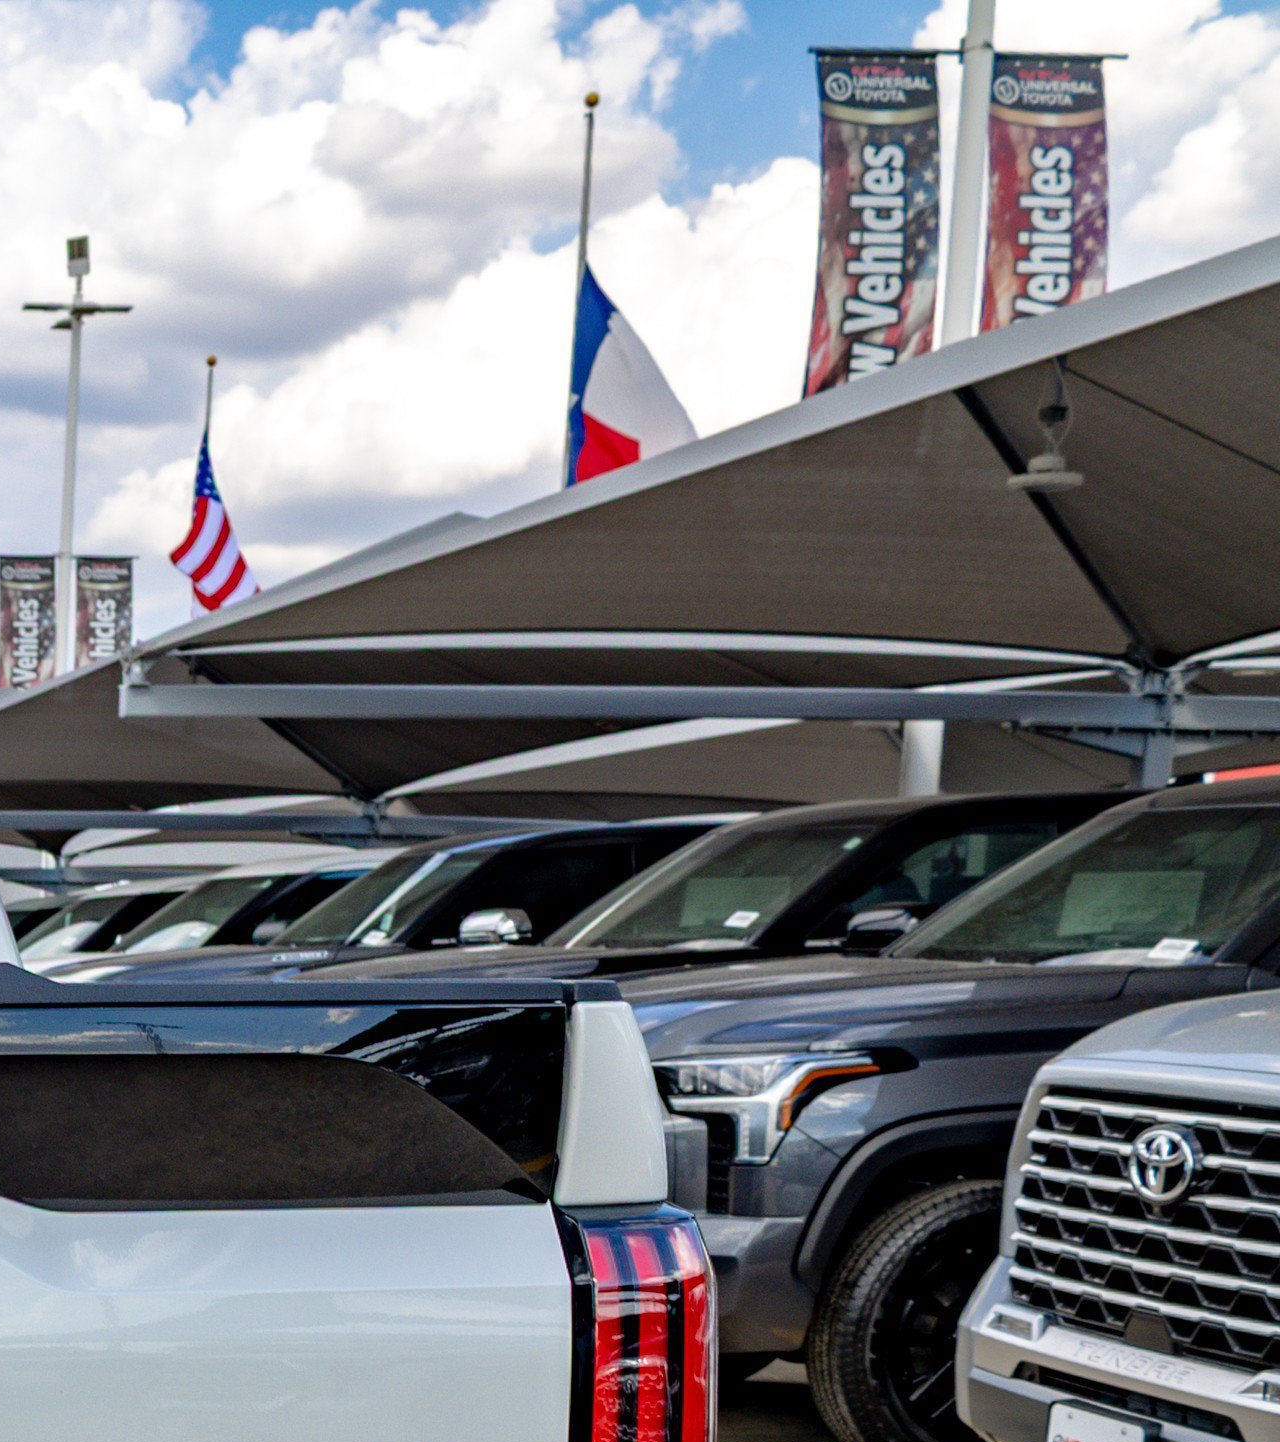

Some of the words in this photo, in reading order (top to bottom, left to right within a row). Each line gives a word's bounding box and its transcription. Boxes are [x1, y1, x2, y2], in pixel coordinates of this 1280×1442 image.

[852, 76, 932, 91] UNIVERSAL
[1021, 80, 1097, 95] UNIVERSAL
[854, 90, 907, 103] TOYOTA
[1022, 93, 1073, 106] TOYOTA
[842, 143, 905, 335] Vehicles
[12, 598, 40, 684] Vehicles
[1075, 1340, 1197, 1384] TUNDRA
